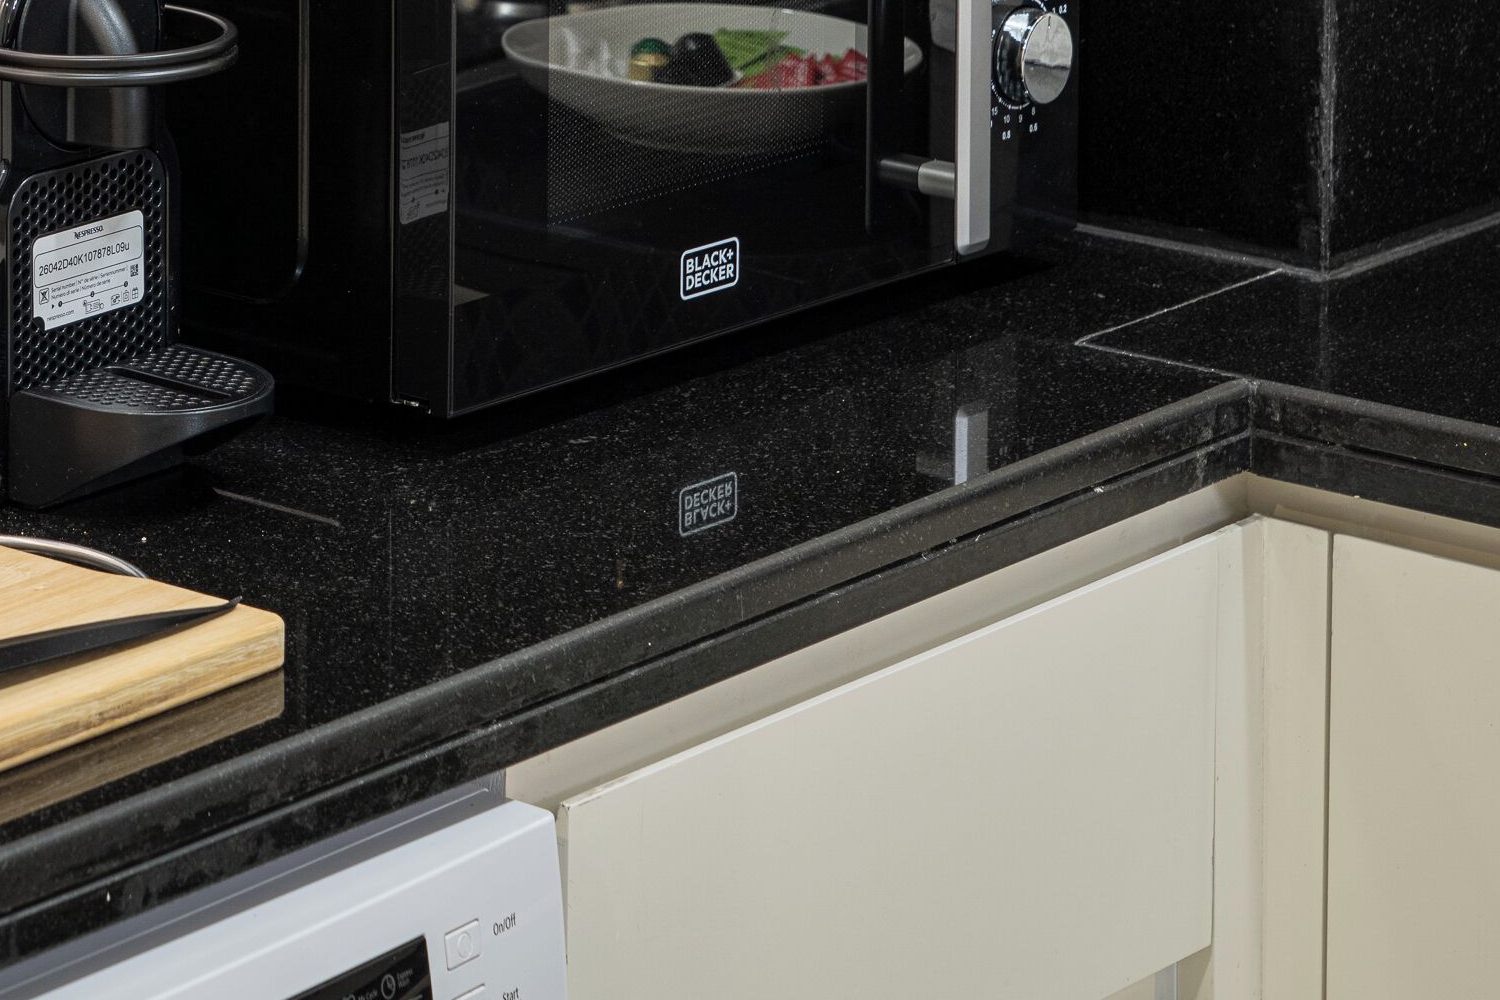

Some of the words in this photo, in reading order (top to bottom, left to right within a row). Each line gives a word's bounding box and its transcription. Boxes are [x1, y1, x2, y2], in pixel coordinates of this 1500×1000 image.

[1058, 4, 1067, 14] 0.2
[1003, 114, 1011, 124] 10
[39, 241, 130, 276] 26042D40K107878L09u
[686, 248, 734, 274] BLACK+
[685, 263, 734, 291] DECKER
[492, 912, 516, 936] On/Off
